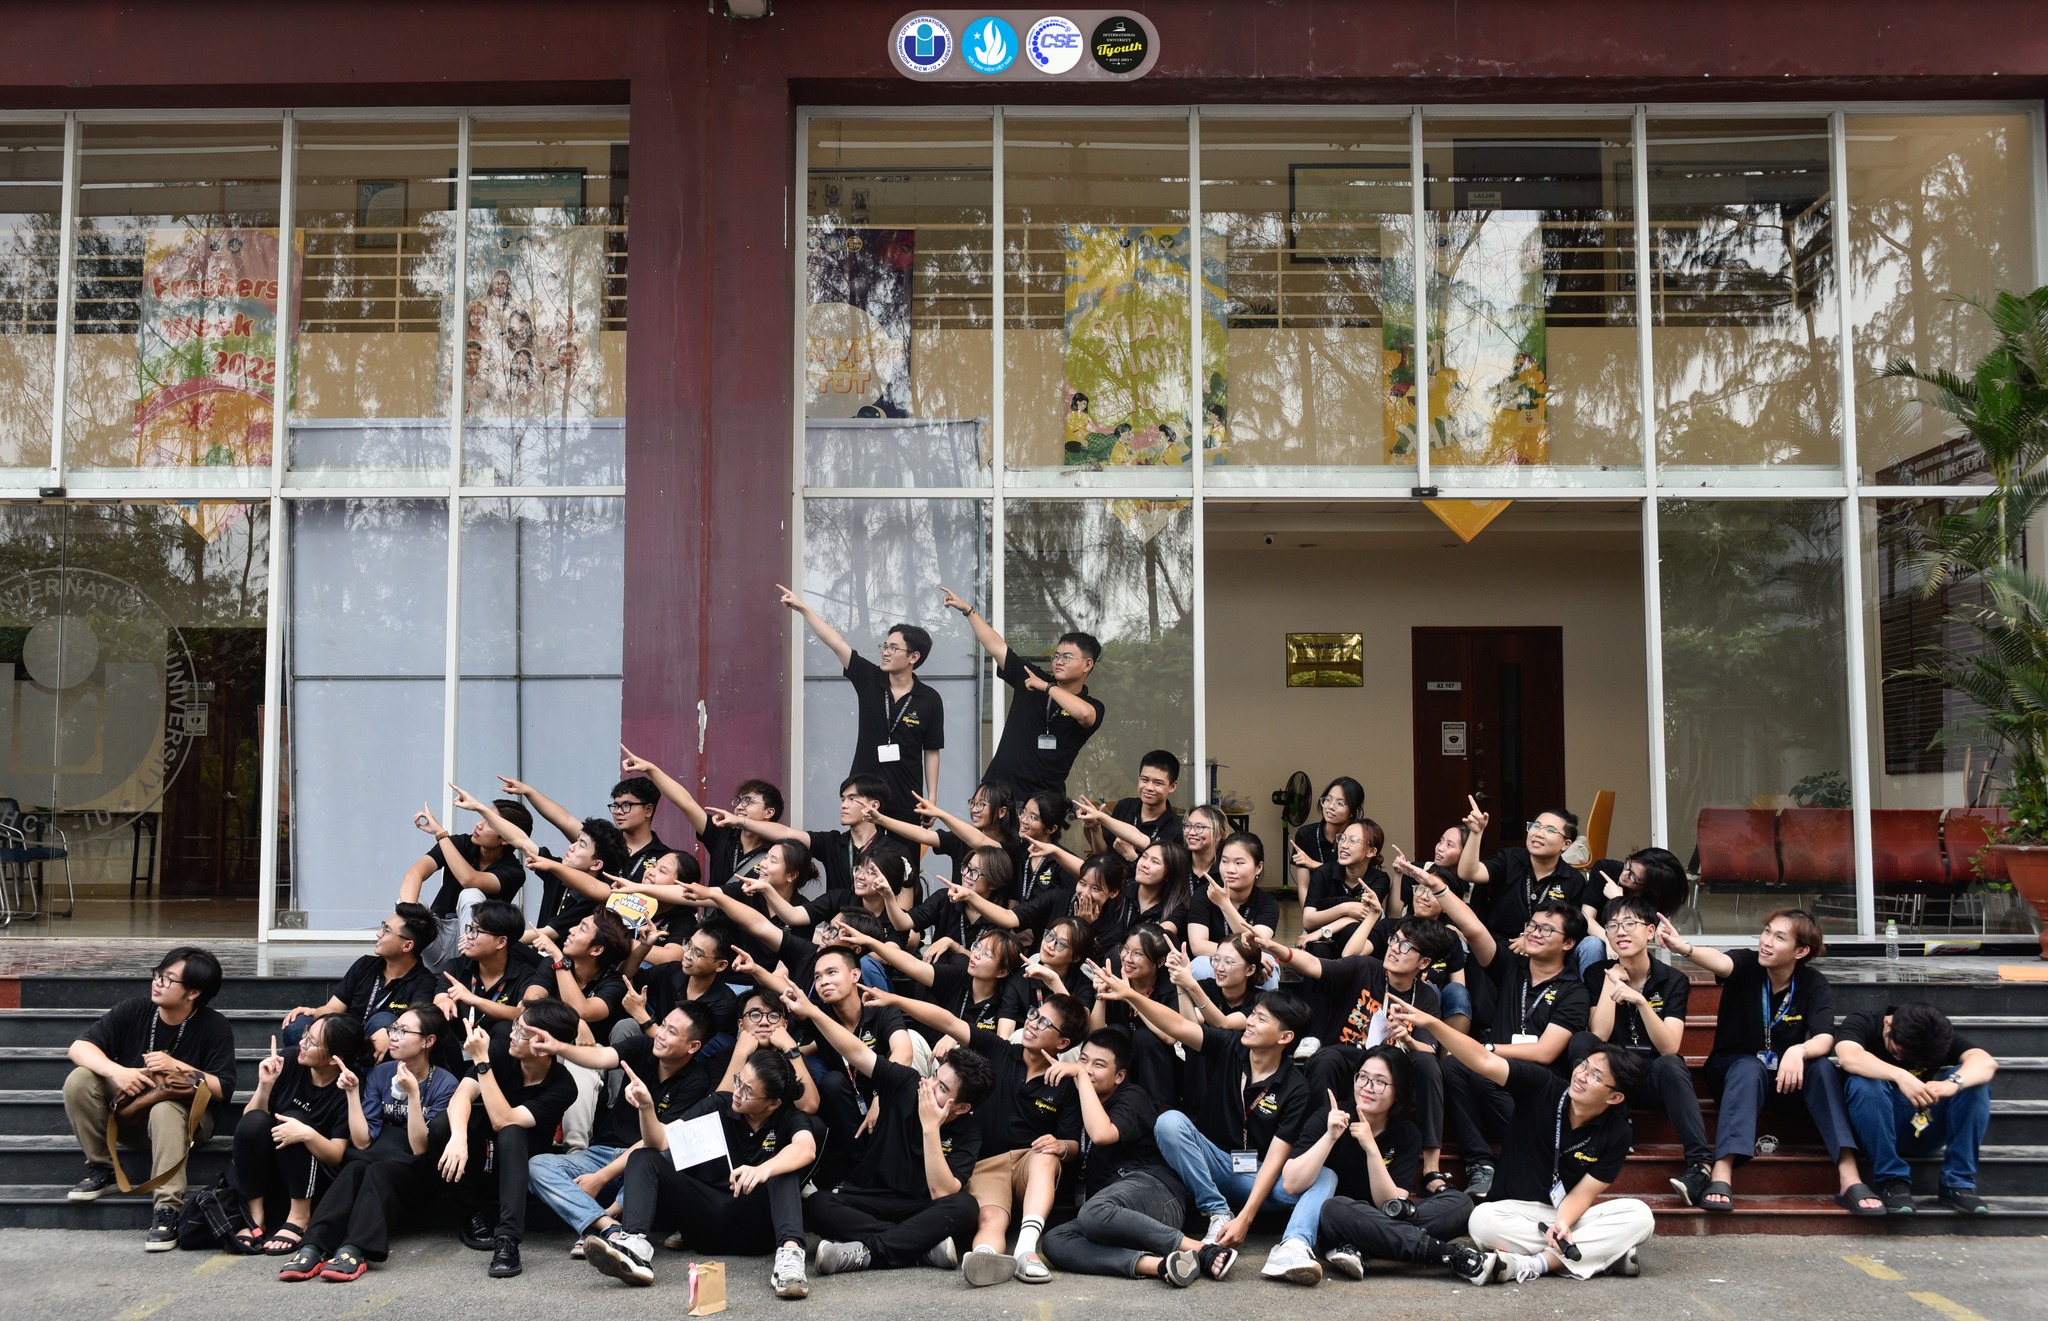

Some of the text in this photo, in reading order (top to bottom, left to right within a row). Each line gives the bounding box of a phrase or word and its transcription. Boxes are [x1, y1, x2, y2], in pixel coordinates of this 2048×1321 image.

[152, 272, 278, 300] Freshers
[1090, 307, 1181, 357] XUÂN
[210, 350, 276, 385] 2022
[1938, 451, 1986, 483] DIRECTORY
[620, 898, 648, 913] WESET
[626, 893, 640, 905] WE
